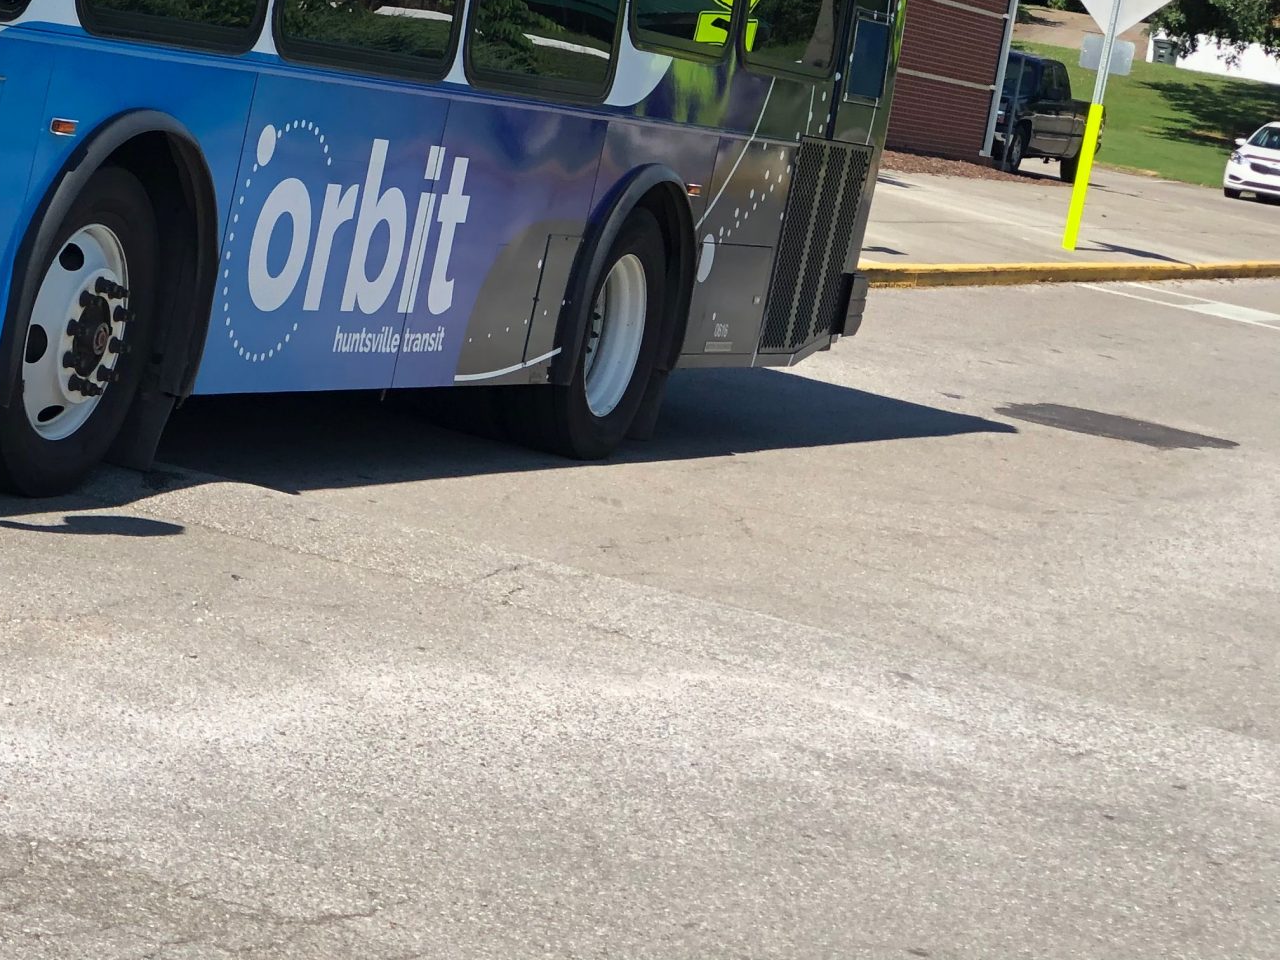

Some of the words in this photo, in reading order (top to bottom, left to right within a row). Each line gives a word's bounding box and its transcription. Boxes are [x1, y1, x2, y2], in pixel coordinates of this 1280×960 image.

[248, 138, 470, 315] orbit
[332, 326, 401, 354] huntsville
[402, 326, 445, 353] transit
